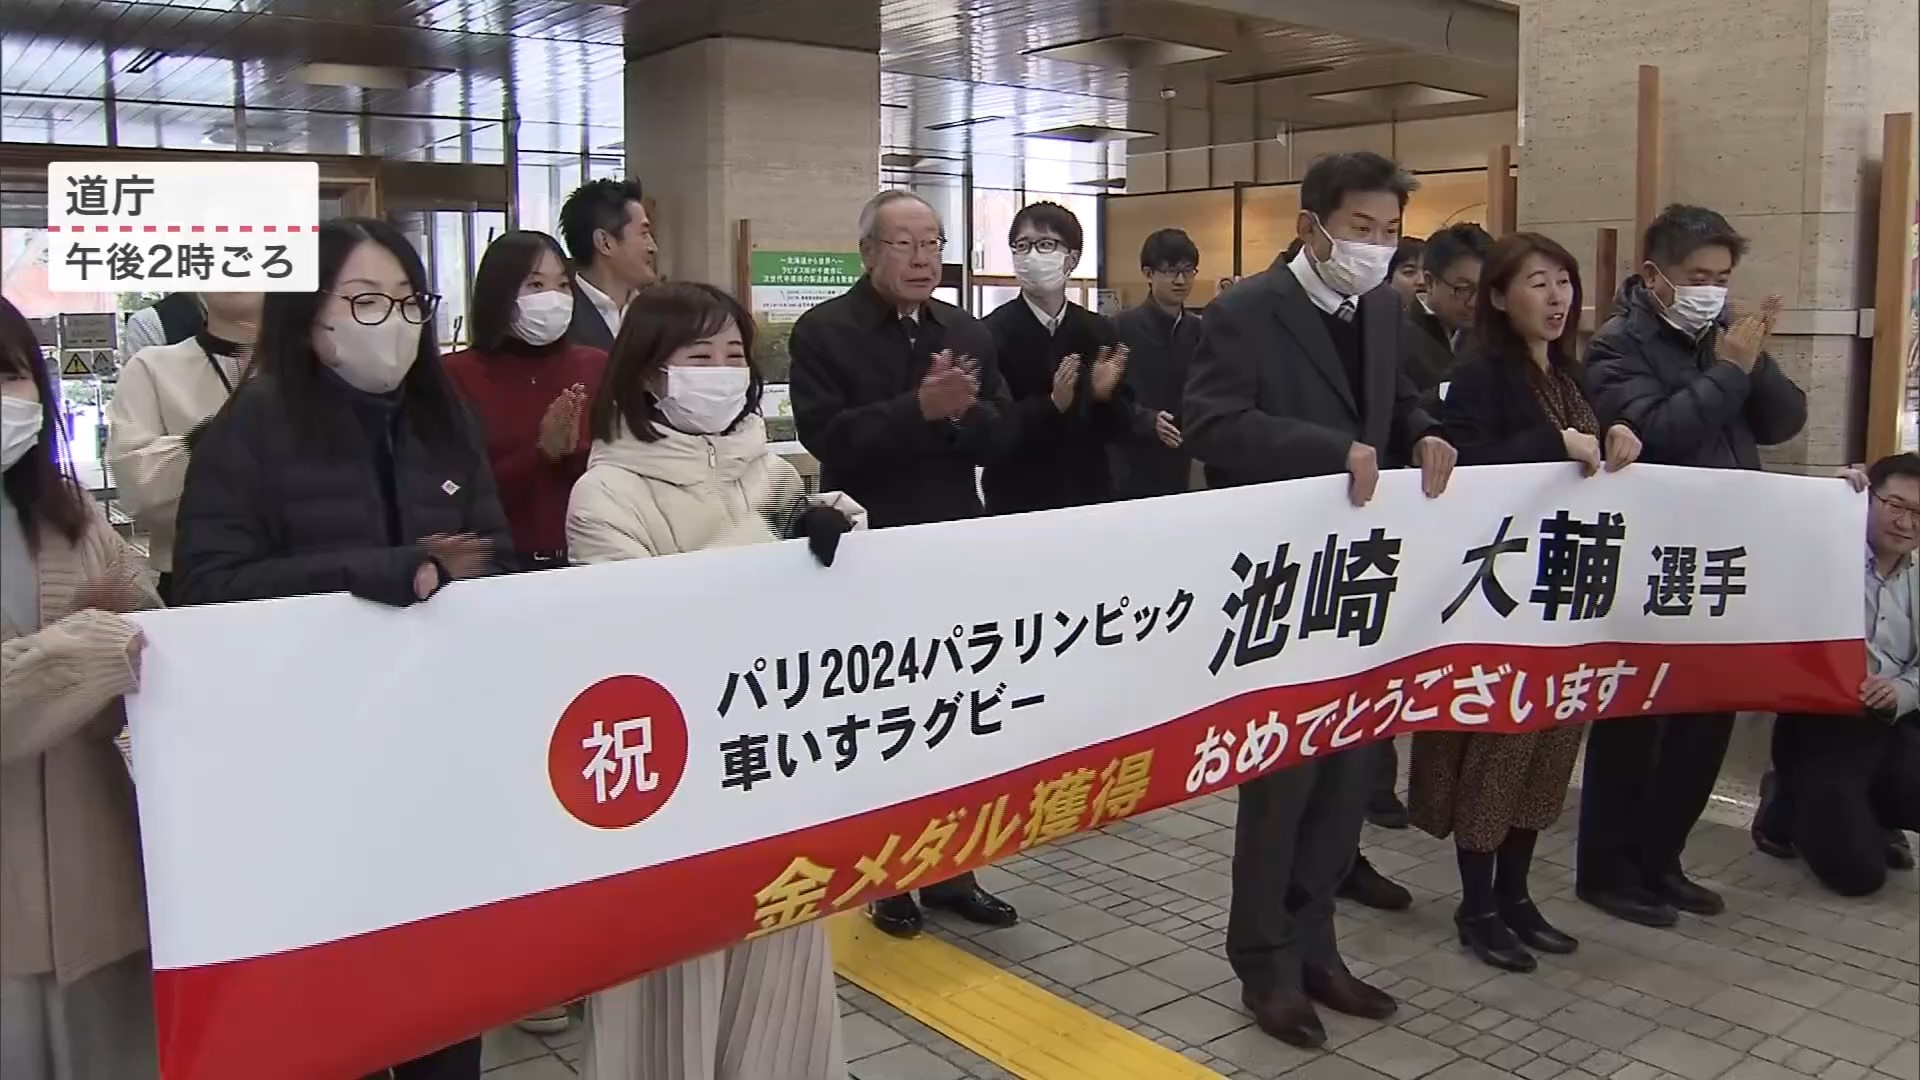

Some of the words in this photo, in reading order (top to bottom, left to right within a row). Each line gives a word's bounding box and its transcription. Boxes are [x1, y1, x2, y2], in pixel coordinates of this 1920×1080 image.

[717, 588, 1195, 718] パリ2024パラリンピック
[1208, 527, 1402, 676] 池崎
[1441, 510, 1626, 623] 大輔
[1643, 545, 1748, 616] 選手
[581, 716, 658, 803] 祝
[719, 683, 1046, 792] 車いすラグビー
[745, 748, 1154, 940] 金メダル獲得
